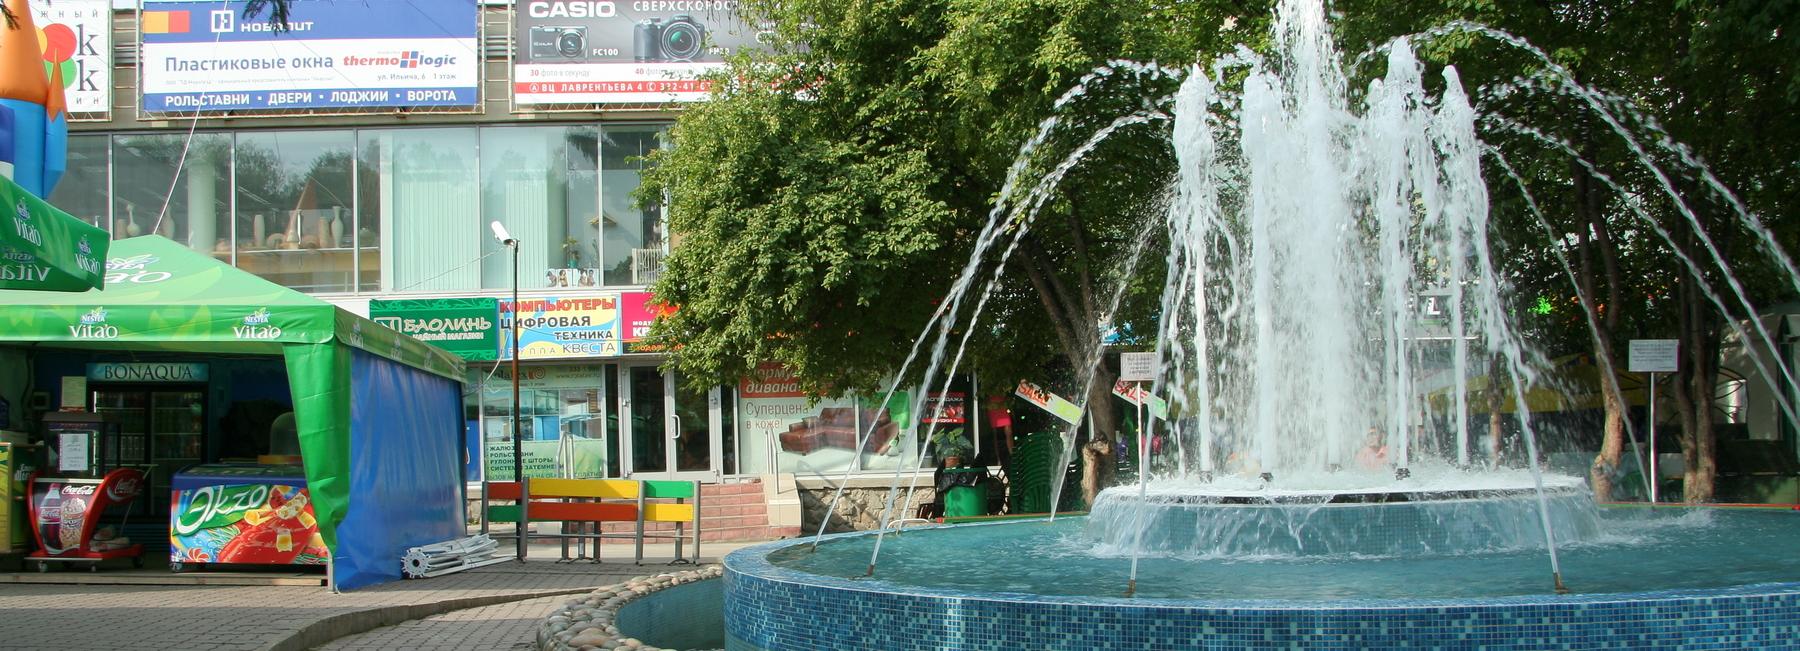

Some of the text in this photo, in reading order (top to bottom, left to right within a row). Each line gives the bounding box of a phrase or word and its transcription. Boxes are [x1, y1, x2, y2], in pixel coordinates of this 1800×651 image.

[529, 1, 616, 18] CASIO
[593, 48, 618, 56] FC100
[165, 56, 334, 72] Пластиковые окна
[343, 54, 456, 67] thermo logic
[530, 69, 539, 77] 30
[541, 83, 555, 93] ВЦ
[561, 83, 633, 92] ЛАВРЕНТЬЕВА
[637, 83, 643, 91] 4
[165, 90, 457, 107] РОЛЬСТАВНИ ДВЕРИ ЛОДЖИИ ВОРОТА
[500, 298, 617, 313] КОМПЬЮТЕРЫ
[403, 316, 492, 333] БАОЛИНЬ
[500, 316, 591, 330] ЦИФРОВАЯ
[554, 329, 613, 341] ТЕХНИКА
[104, 364, 193, 381] BONAQUA
[61, 485, 97, 495] Coca-Cola
